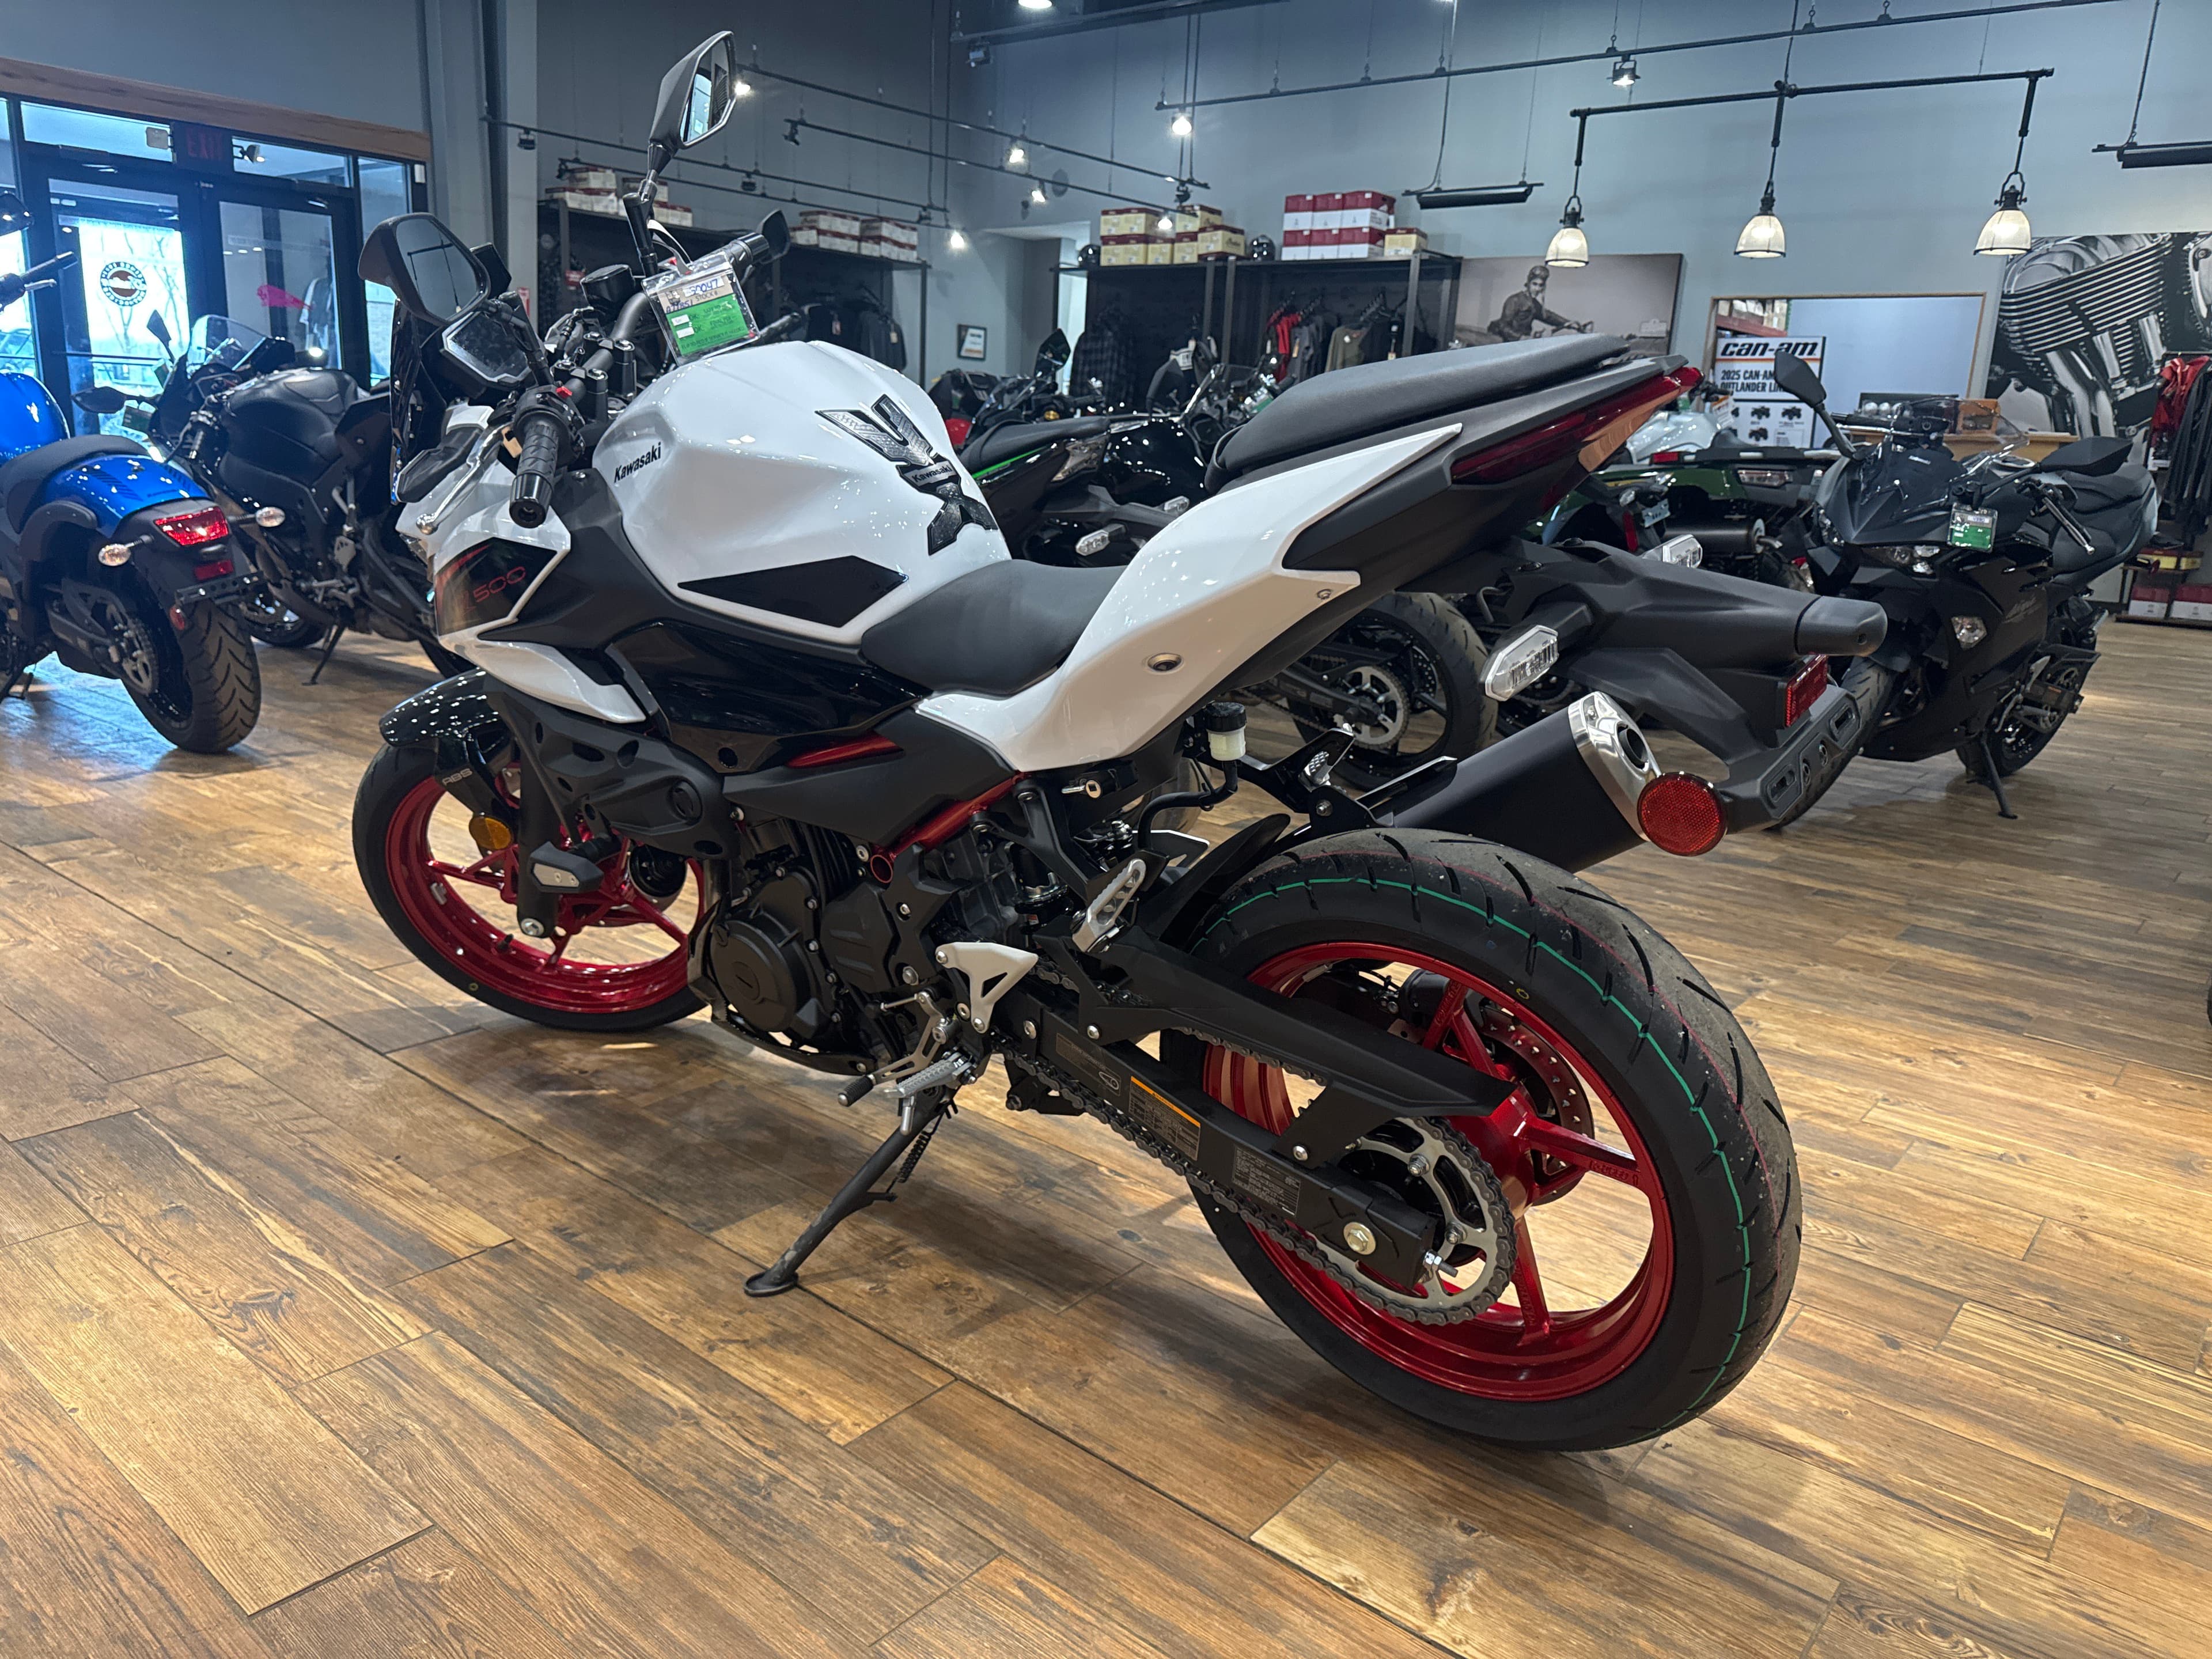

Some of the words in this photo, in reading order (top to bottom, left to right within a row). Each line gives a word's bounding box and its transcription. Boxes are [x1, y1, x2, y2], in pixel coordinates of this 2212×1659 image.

[1720, 342, 1819, 356] can-am
[1721, 370, 1741, 380] 2025
[1720, 381, 1766, 392] OUTLANDER
[614, 441, 661, 483] Kawasaki
[912, 465, 952, 483] Kawasaki
[473, 566, 526, 603] 500
[442, 768, 472, 786] ABS
